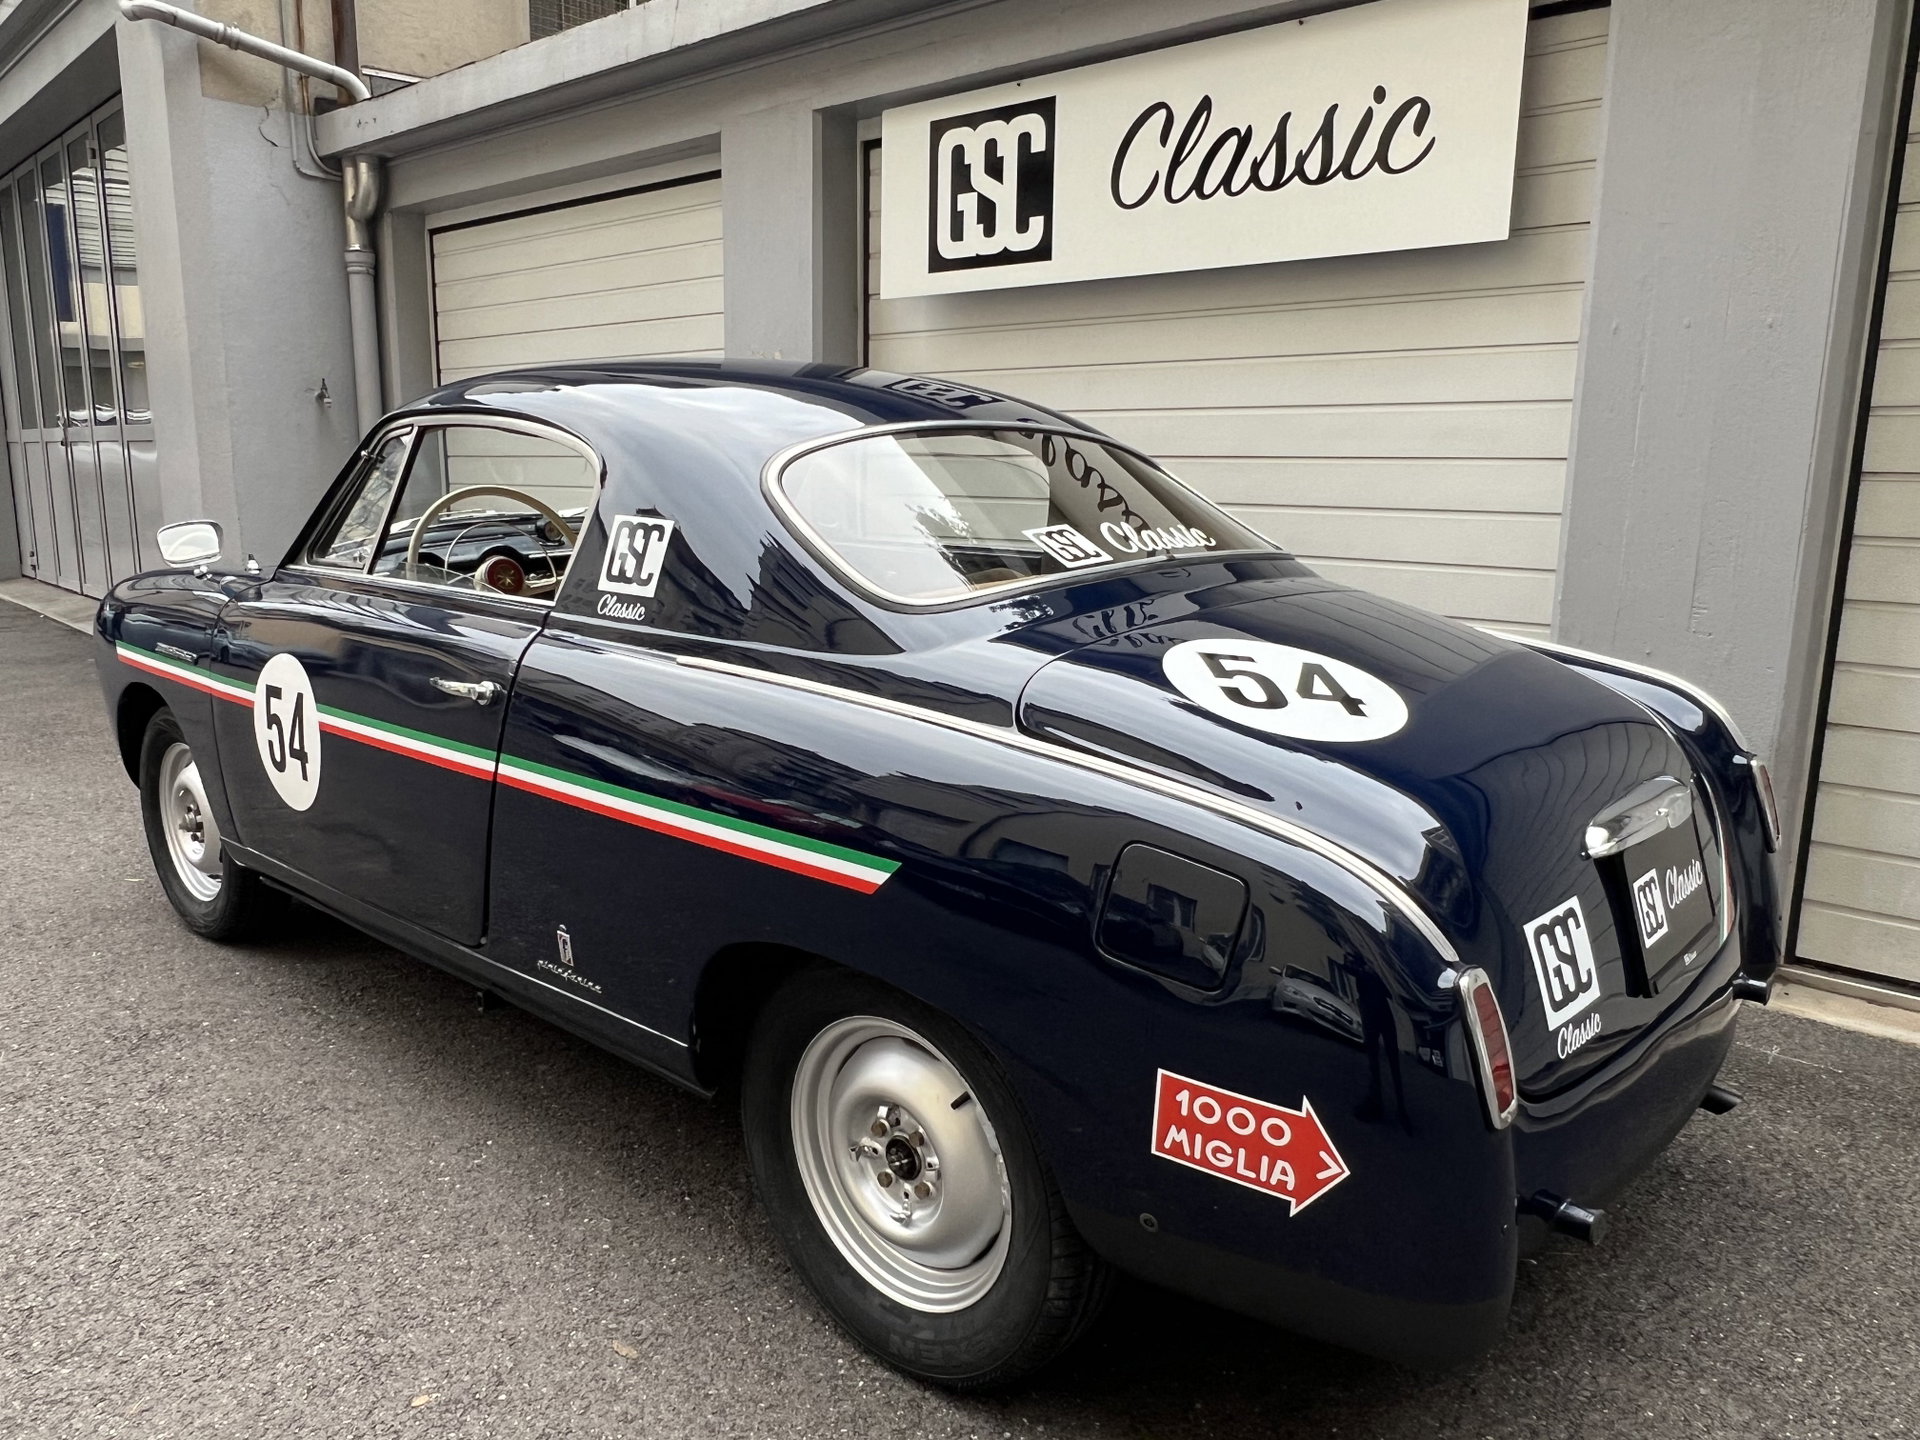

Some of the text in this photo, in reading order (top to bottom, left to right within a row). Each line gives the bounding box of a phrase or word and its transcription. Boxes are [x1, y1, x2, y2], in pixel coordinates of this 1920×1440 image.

[936, 85, 1436, 260] GSC Classic
[606, 521, 665, 587] GSC
[1100, 521, 1217, 553] Classic
[597, 593, 646, 621] Classic
[1196, 652, 1368, 717] 54
[266, 684, 309, 782] 54
[1665, 859, 1703, 910] Classic
[1533, 906, 1593, 1013] GSC
[1557, 1013, 1602, 1059] Classic
[1175, 1089, 1292, 1147] 1000
[1163, 1124, 1296, 1191] MIGLIA
